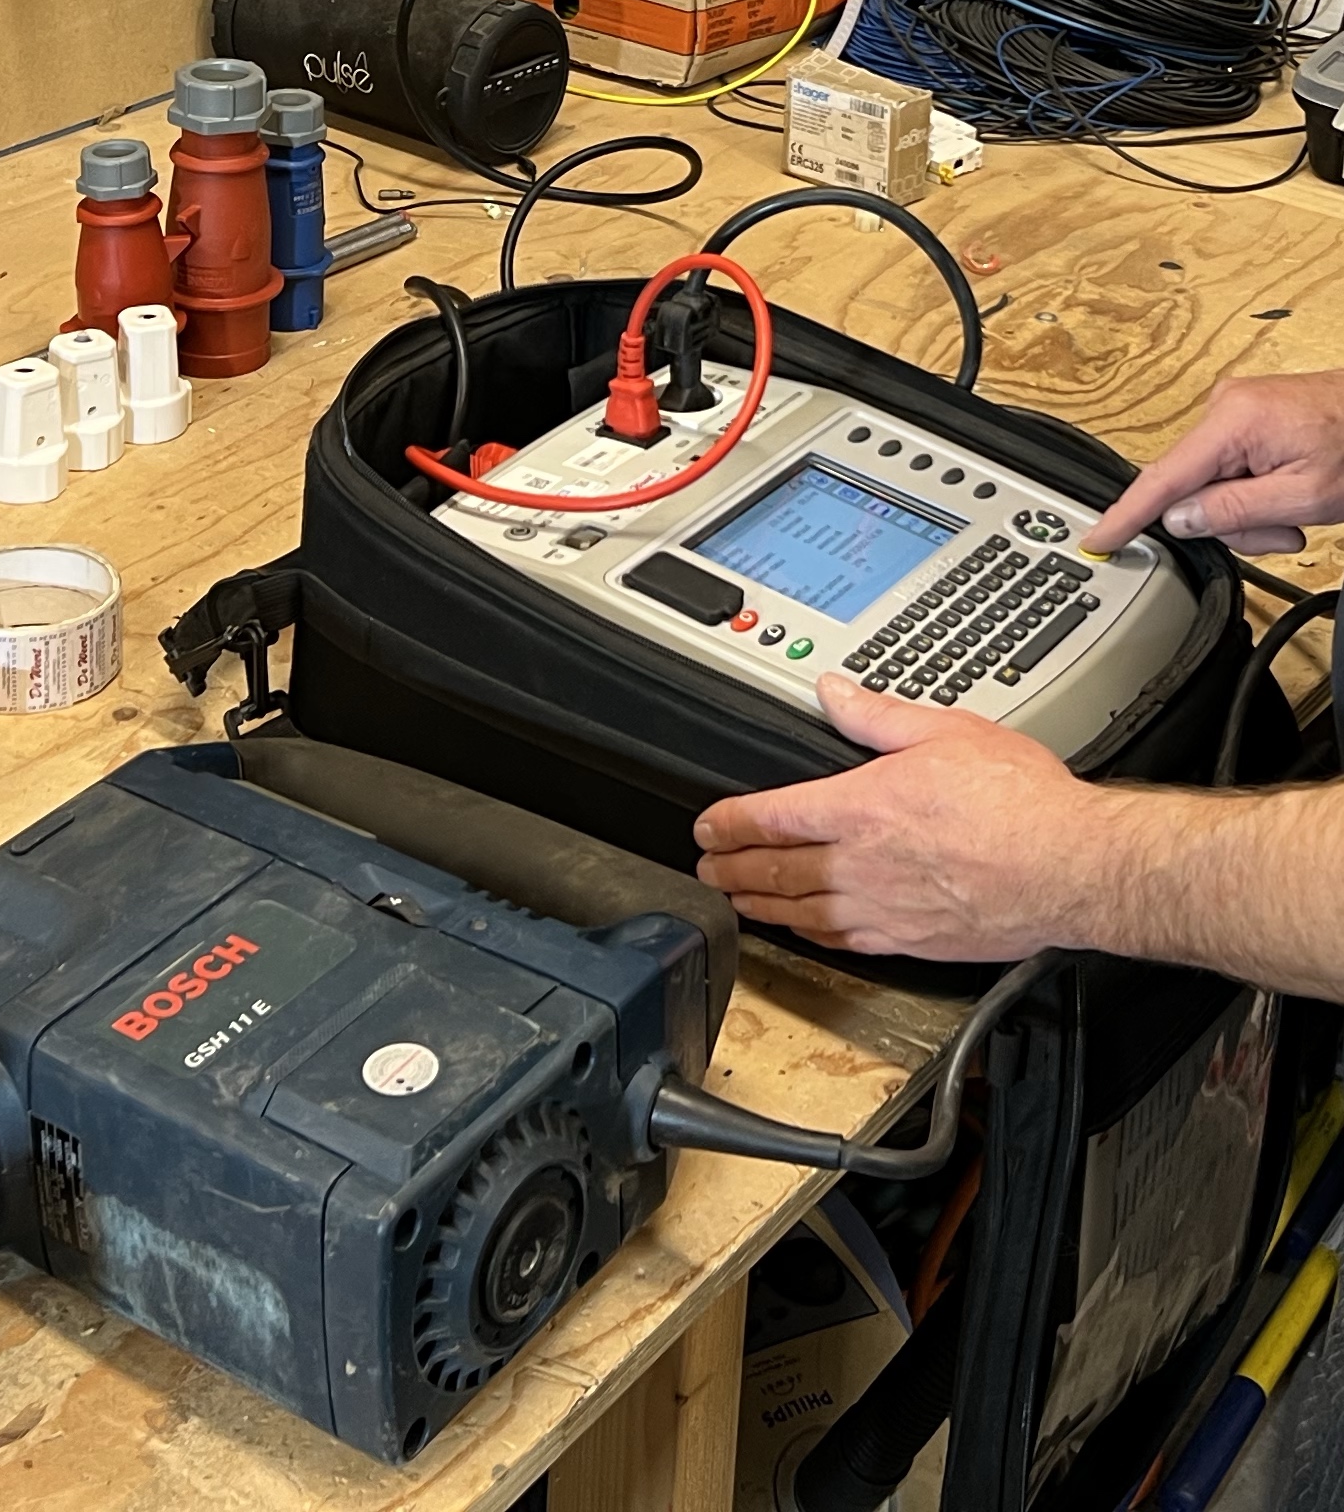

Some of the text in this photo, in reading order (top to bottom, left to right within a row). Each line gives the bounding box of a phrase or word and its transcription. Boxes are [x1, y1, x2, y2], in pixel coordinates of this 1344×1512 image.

[797, 82, 831, 102] hager
[790, 154, 824, 174] ERC325
[111, 933, 261, 1042] BOSCH
[183, 998, 273, 1070] GSH 11 E
[761, 1390, 833, 1429] PHILIPS
